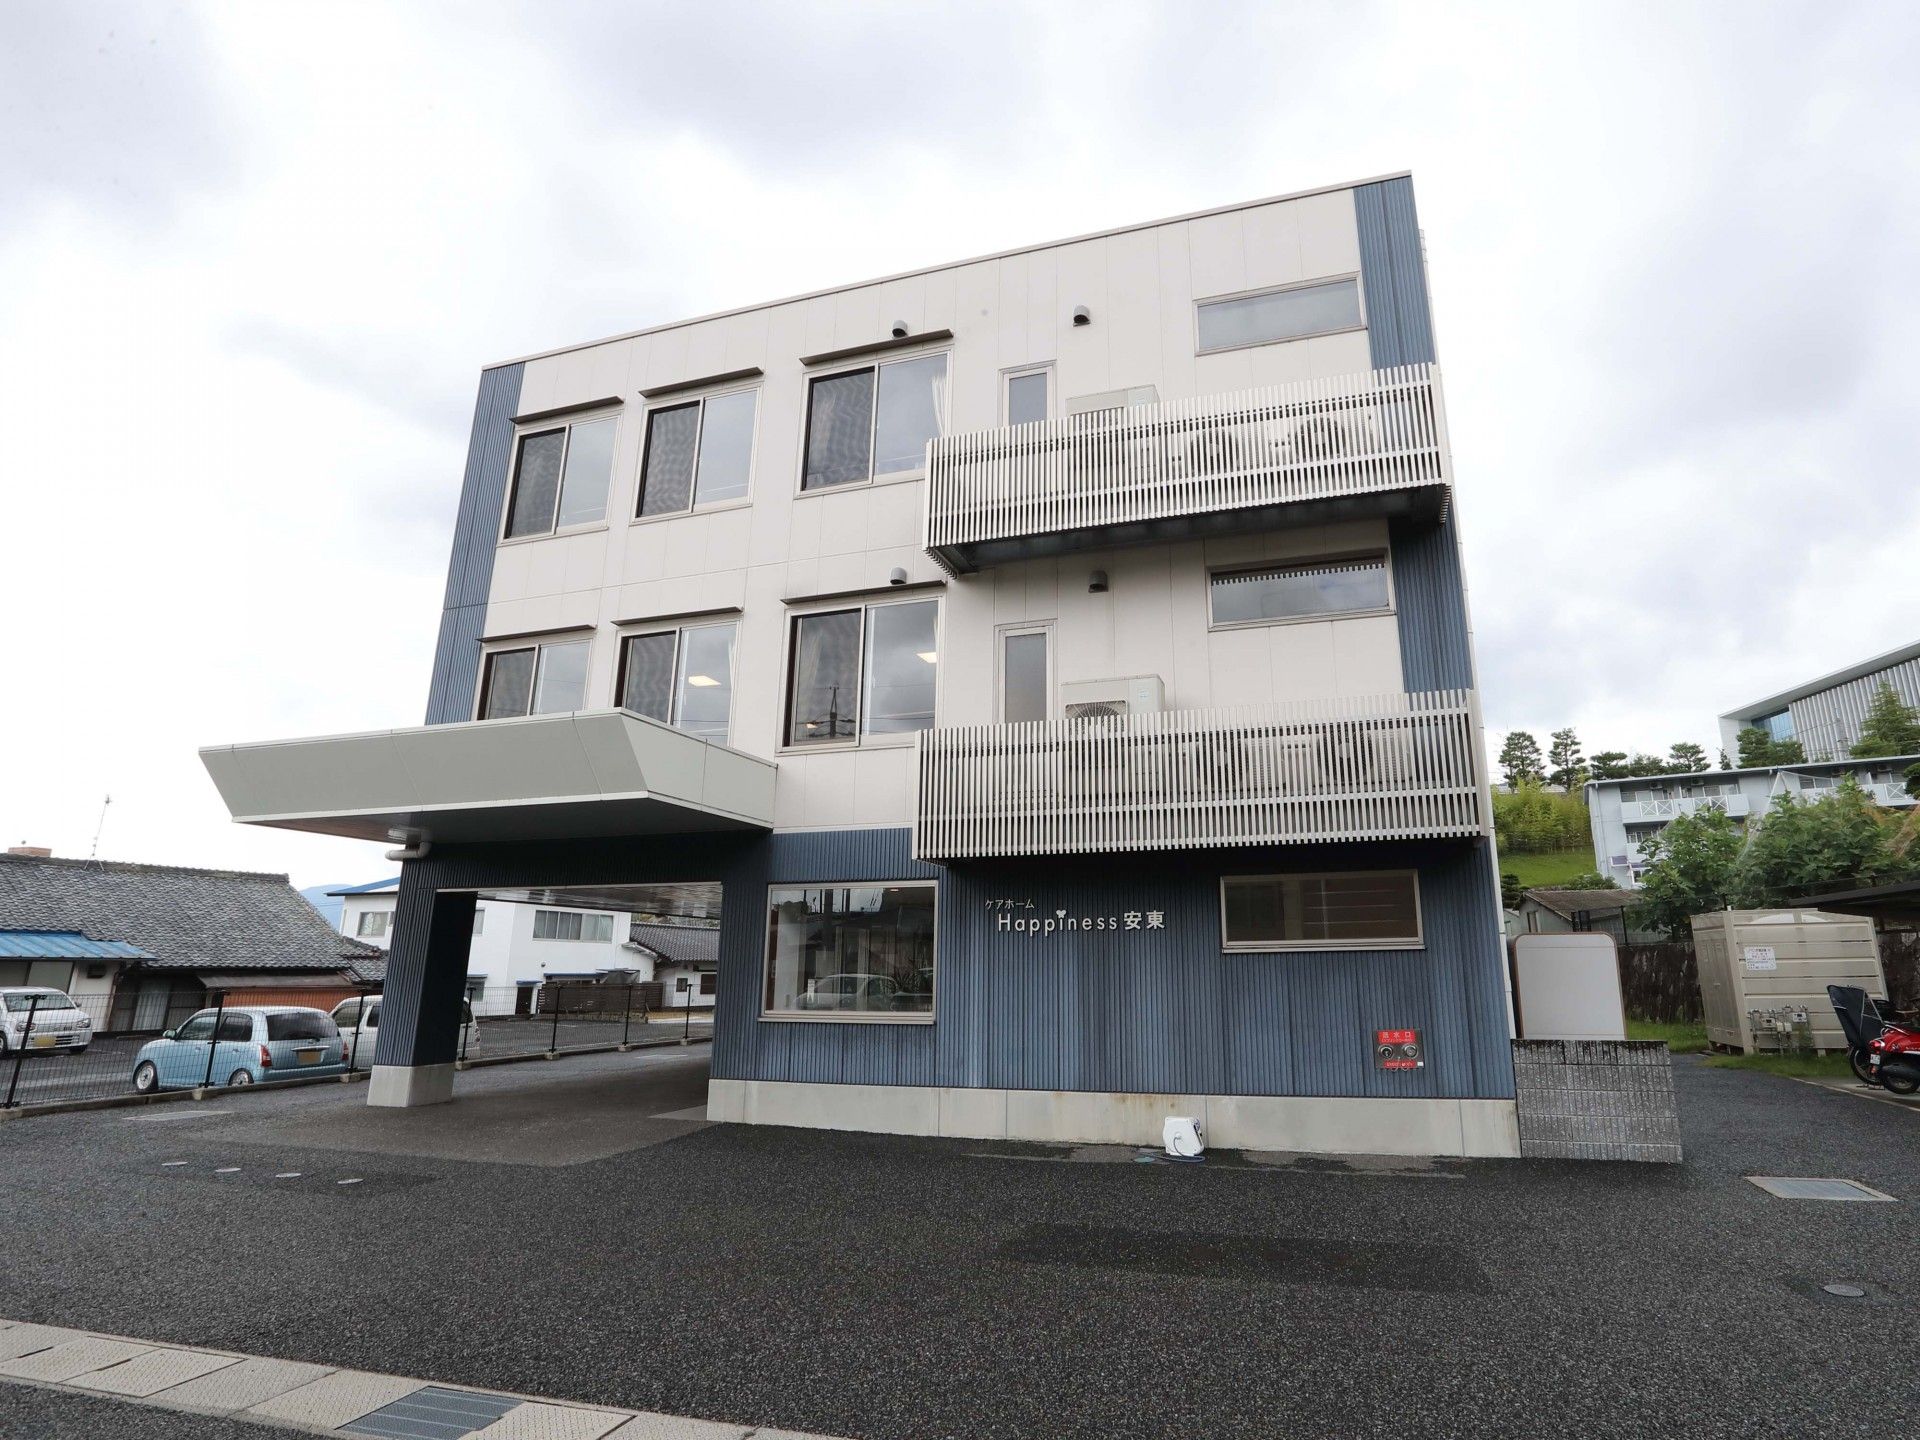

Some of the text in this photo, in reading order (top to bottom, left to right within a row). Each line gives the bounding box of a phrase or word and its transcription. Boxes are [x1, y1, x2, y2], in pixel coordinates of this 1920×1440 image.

[985, 899, 1035, 909] ケアホーム
[998, 910, 1165, 936] Happiness 安東
